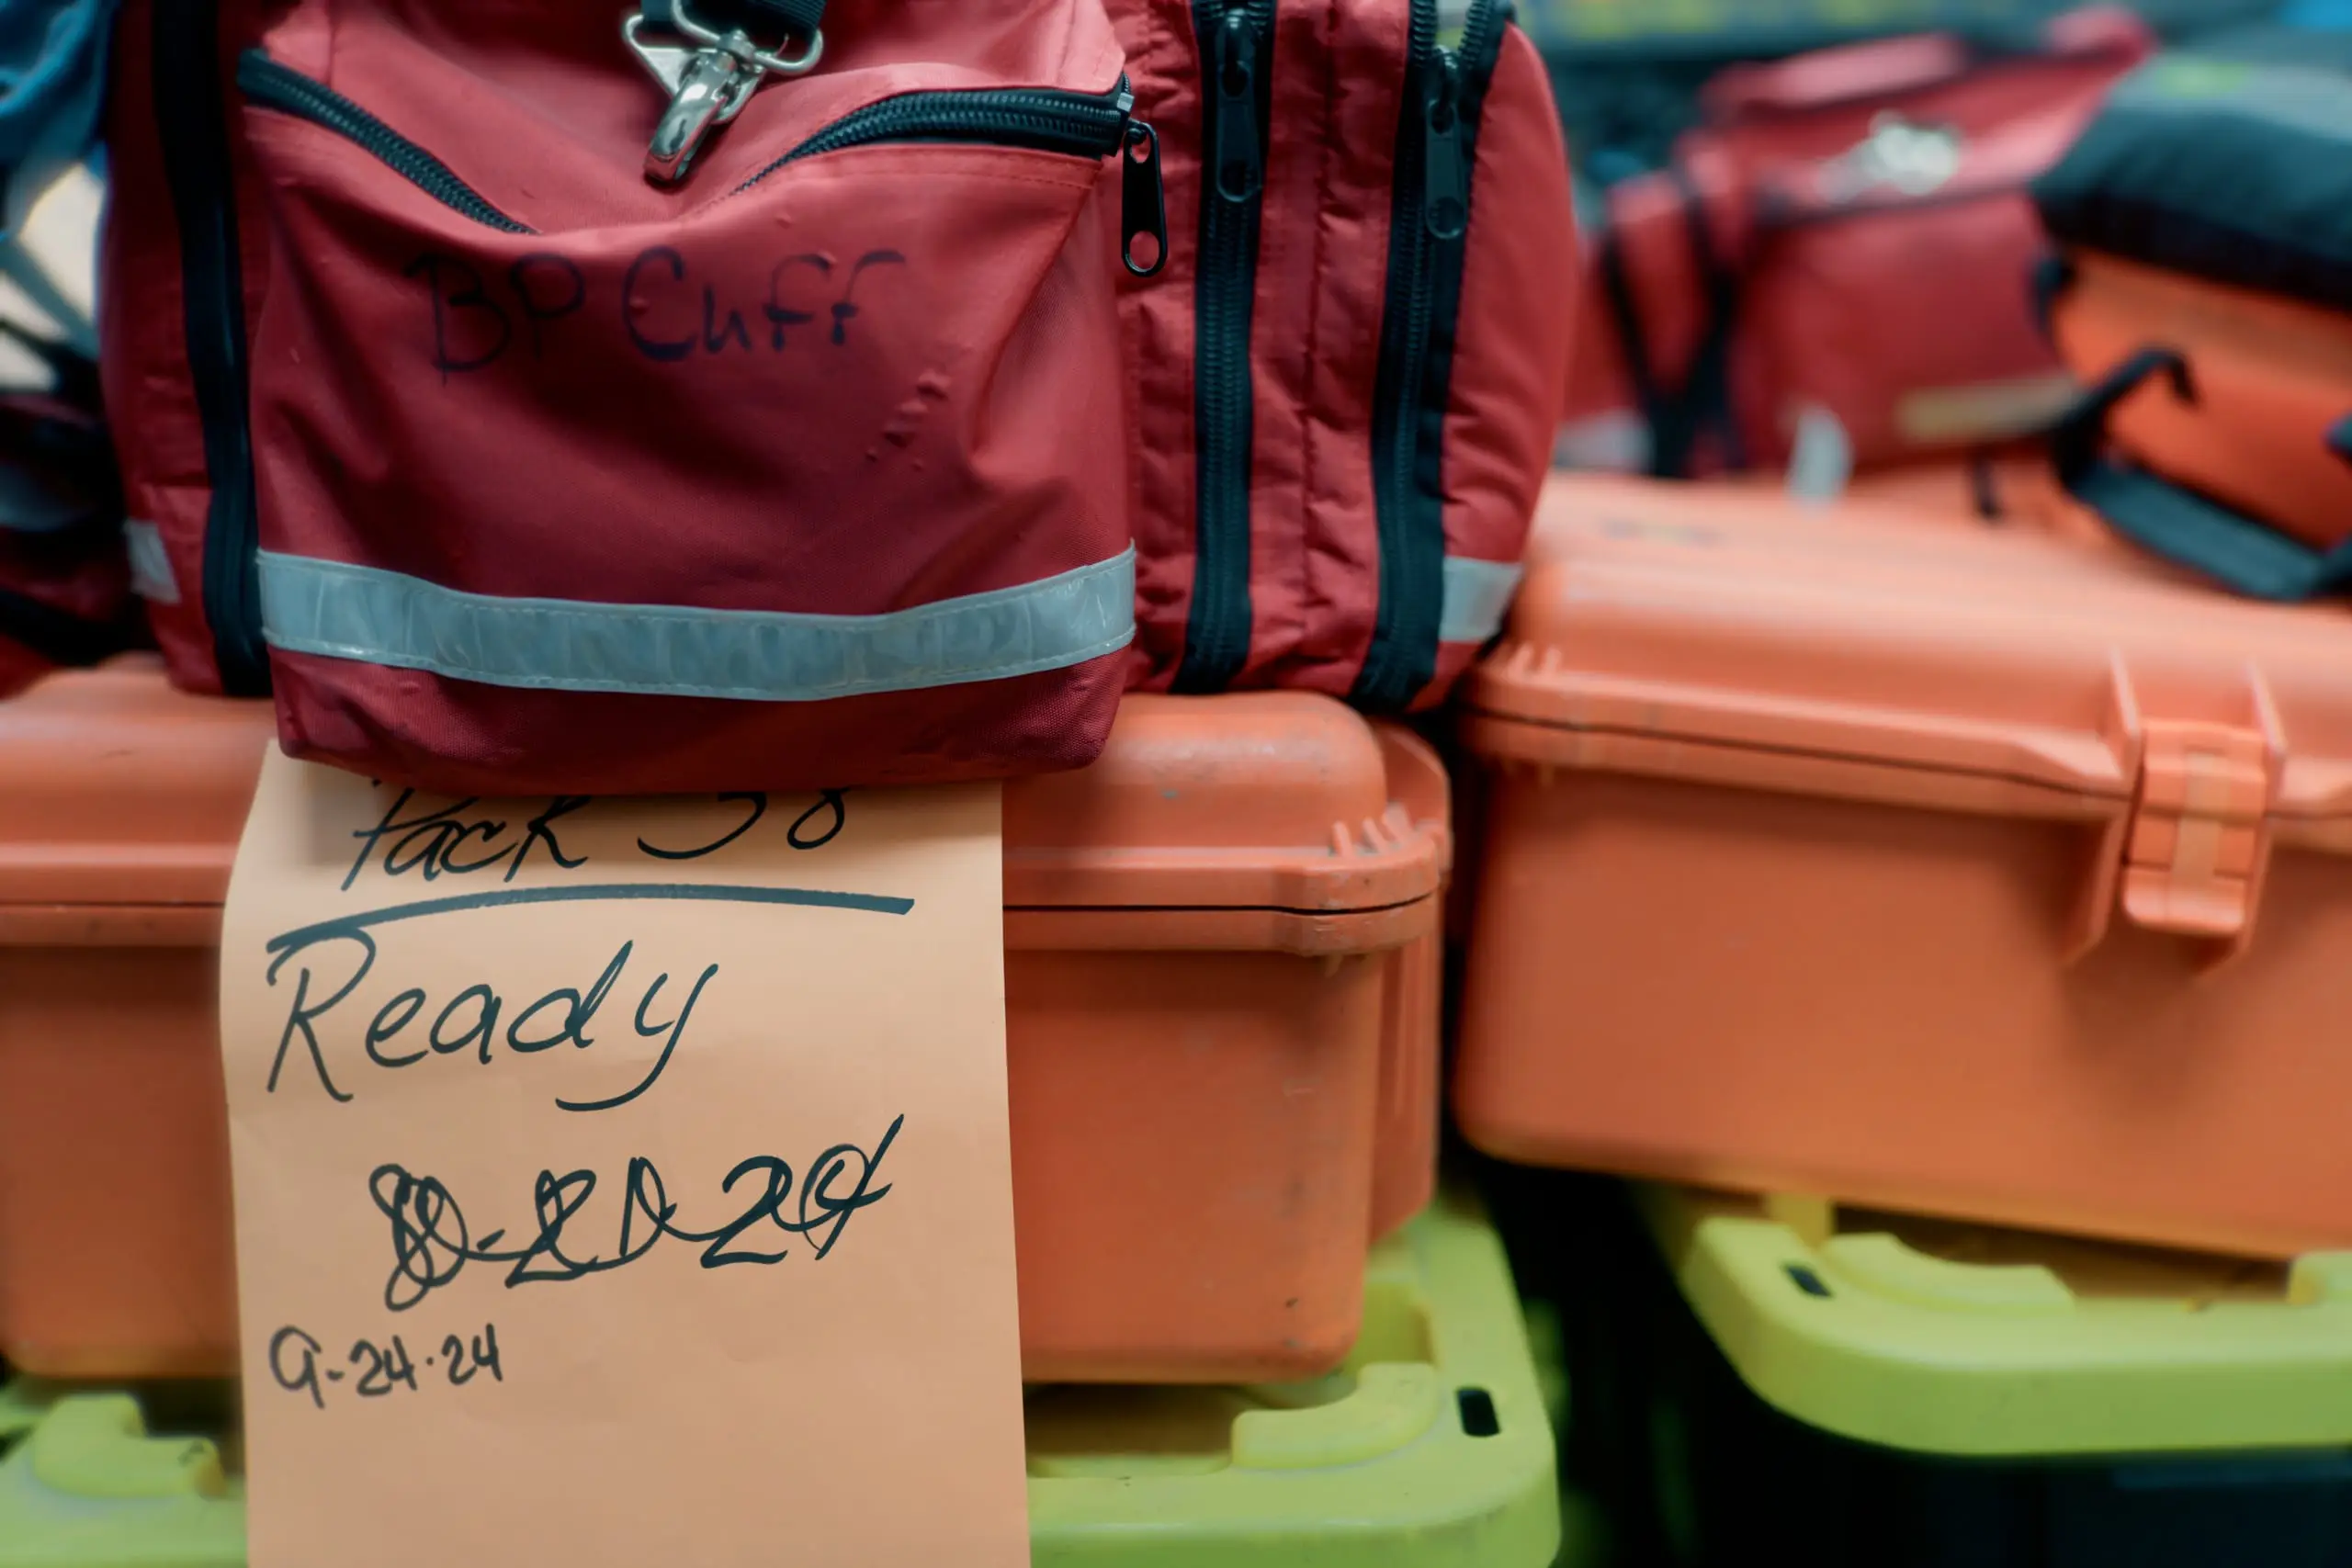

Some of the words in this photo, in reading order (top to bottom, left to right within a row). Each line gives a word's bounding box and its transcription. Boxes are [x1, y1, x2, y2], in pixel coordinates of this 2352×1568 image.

[402, 250, 586, 387] BP
[621, 245, 906, 362] Cuff
[266, 924, 720, 1112] Ready
